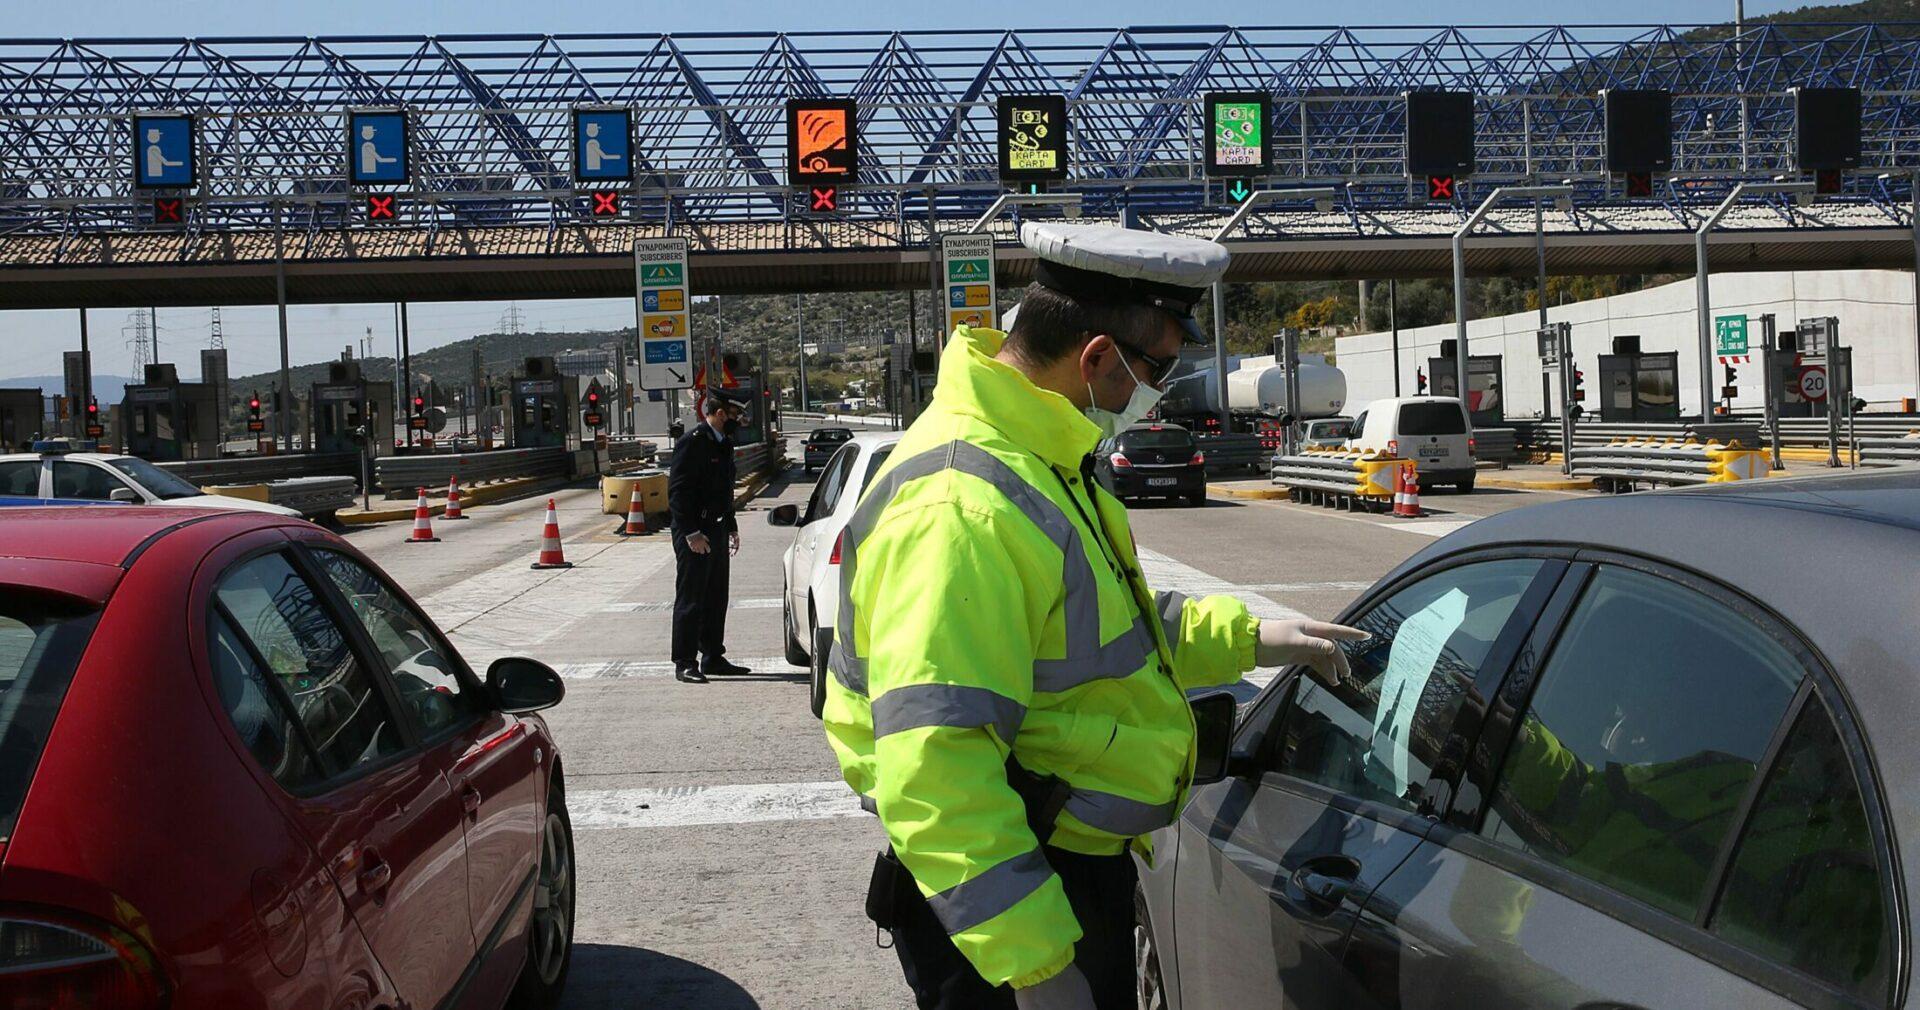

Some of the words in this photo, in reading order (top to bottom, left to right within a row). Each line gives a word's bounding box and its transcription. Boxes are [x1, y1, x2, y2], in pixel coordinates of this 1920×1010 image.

[1016, 151, 1049, 159] ΚΑΡΤΑ
[1222, 147, 1254, 155] ΚΑΡΤΑ
[1019, 160, 1045, 168] CARD
[1225, 156, 1251, 164] CARD
[637, 243, 684, 252] ΣΥΝΔΡΟΜΗΤΕΣ
[945, 239, 991, 248] ΣΥΝΔΡΟΜΗΤΕΣ
[640, 252, 683, 261] SUBSCRIBERS
[947, 249, 990, 257] SUBSCRIBERS
[1805, 377, 1825, 390] 20
